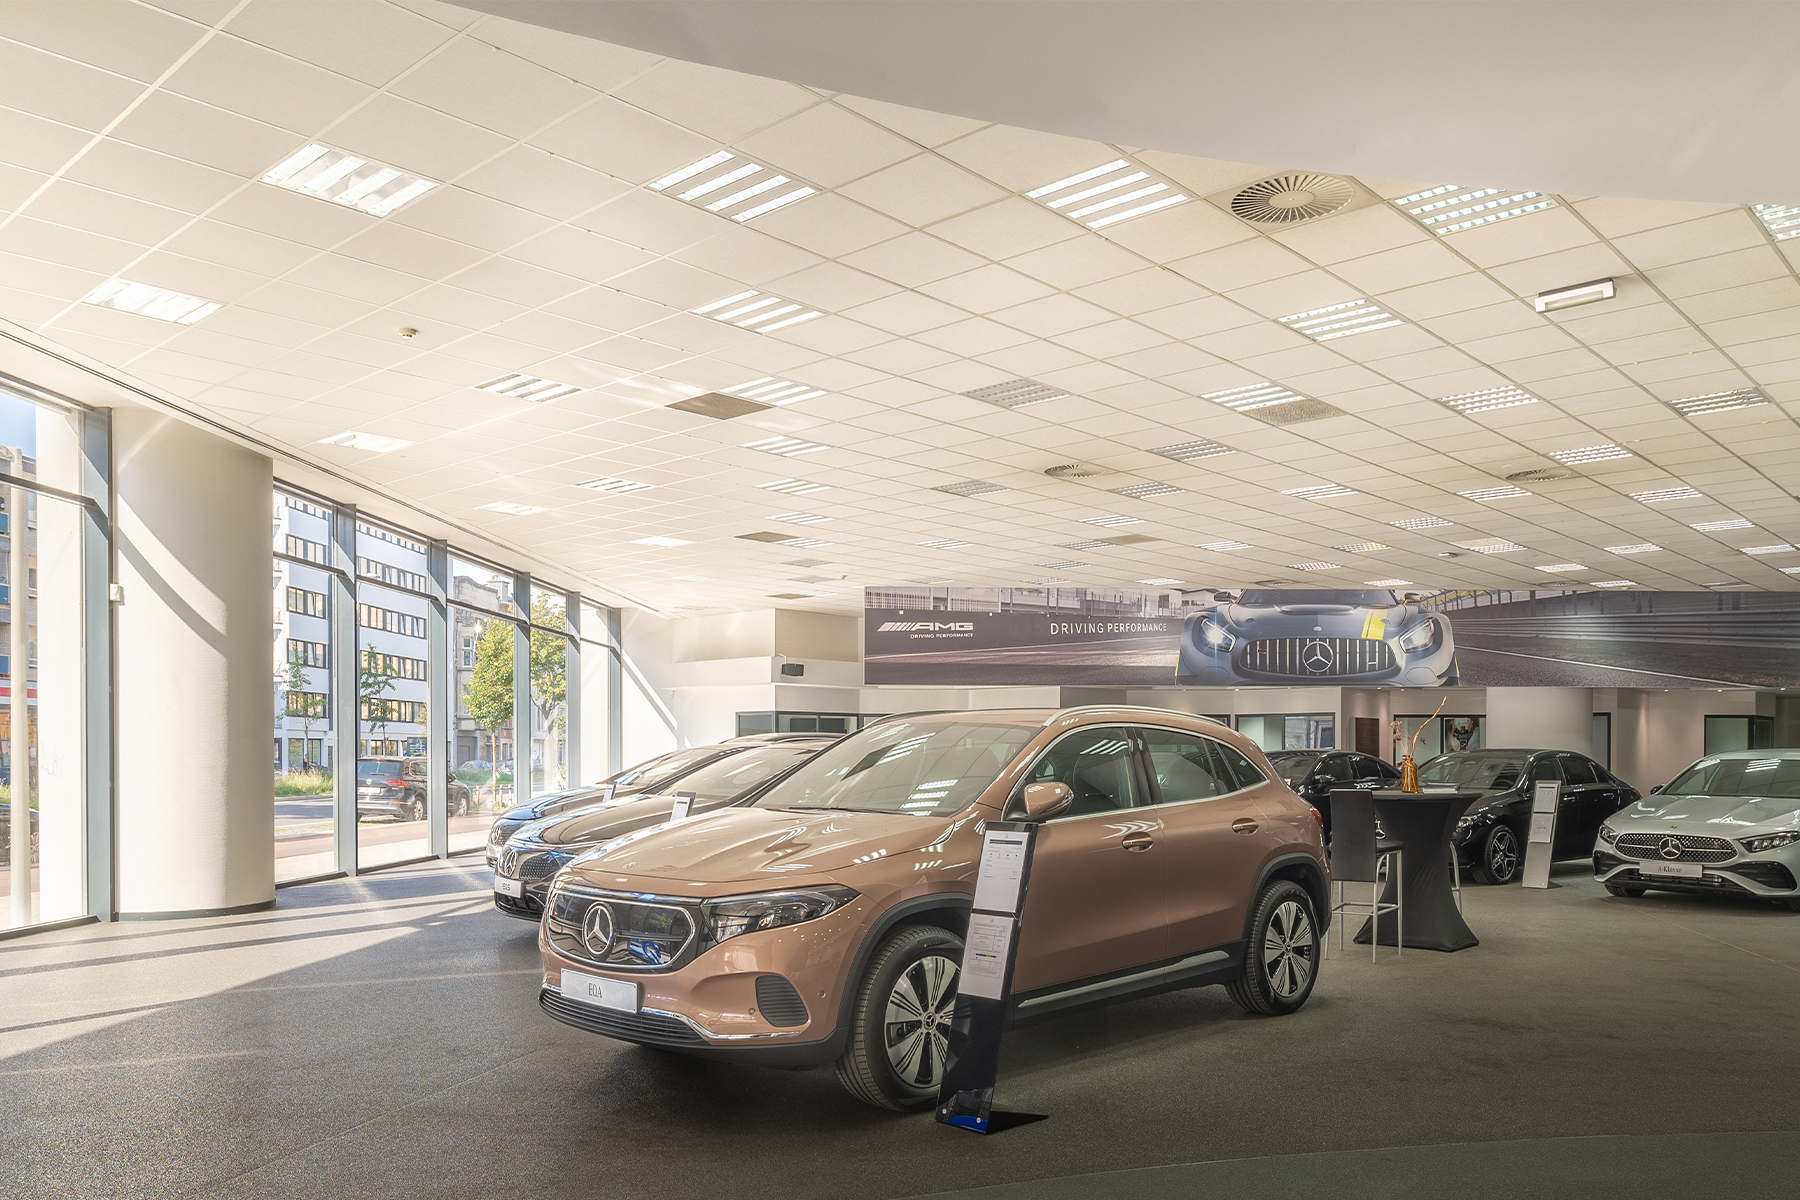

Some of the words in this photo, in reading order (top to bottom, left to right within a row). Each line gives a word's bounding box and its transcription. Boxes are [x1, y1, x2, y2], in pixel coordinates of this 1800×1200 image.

[909, 622, 974, 631] AMG
[1050, 622, 1104, 635] DRIVING
[1107, 622, 1167, 633] PERFORMANCE
[1657, 865, 1683, 874] A-Klasse
[588, 982, 603, 999] EQA
